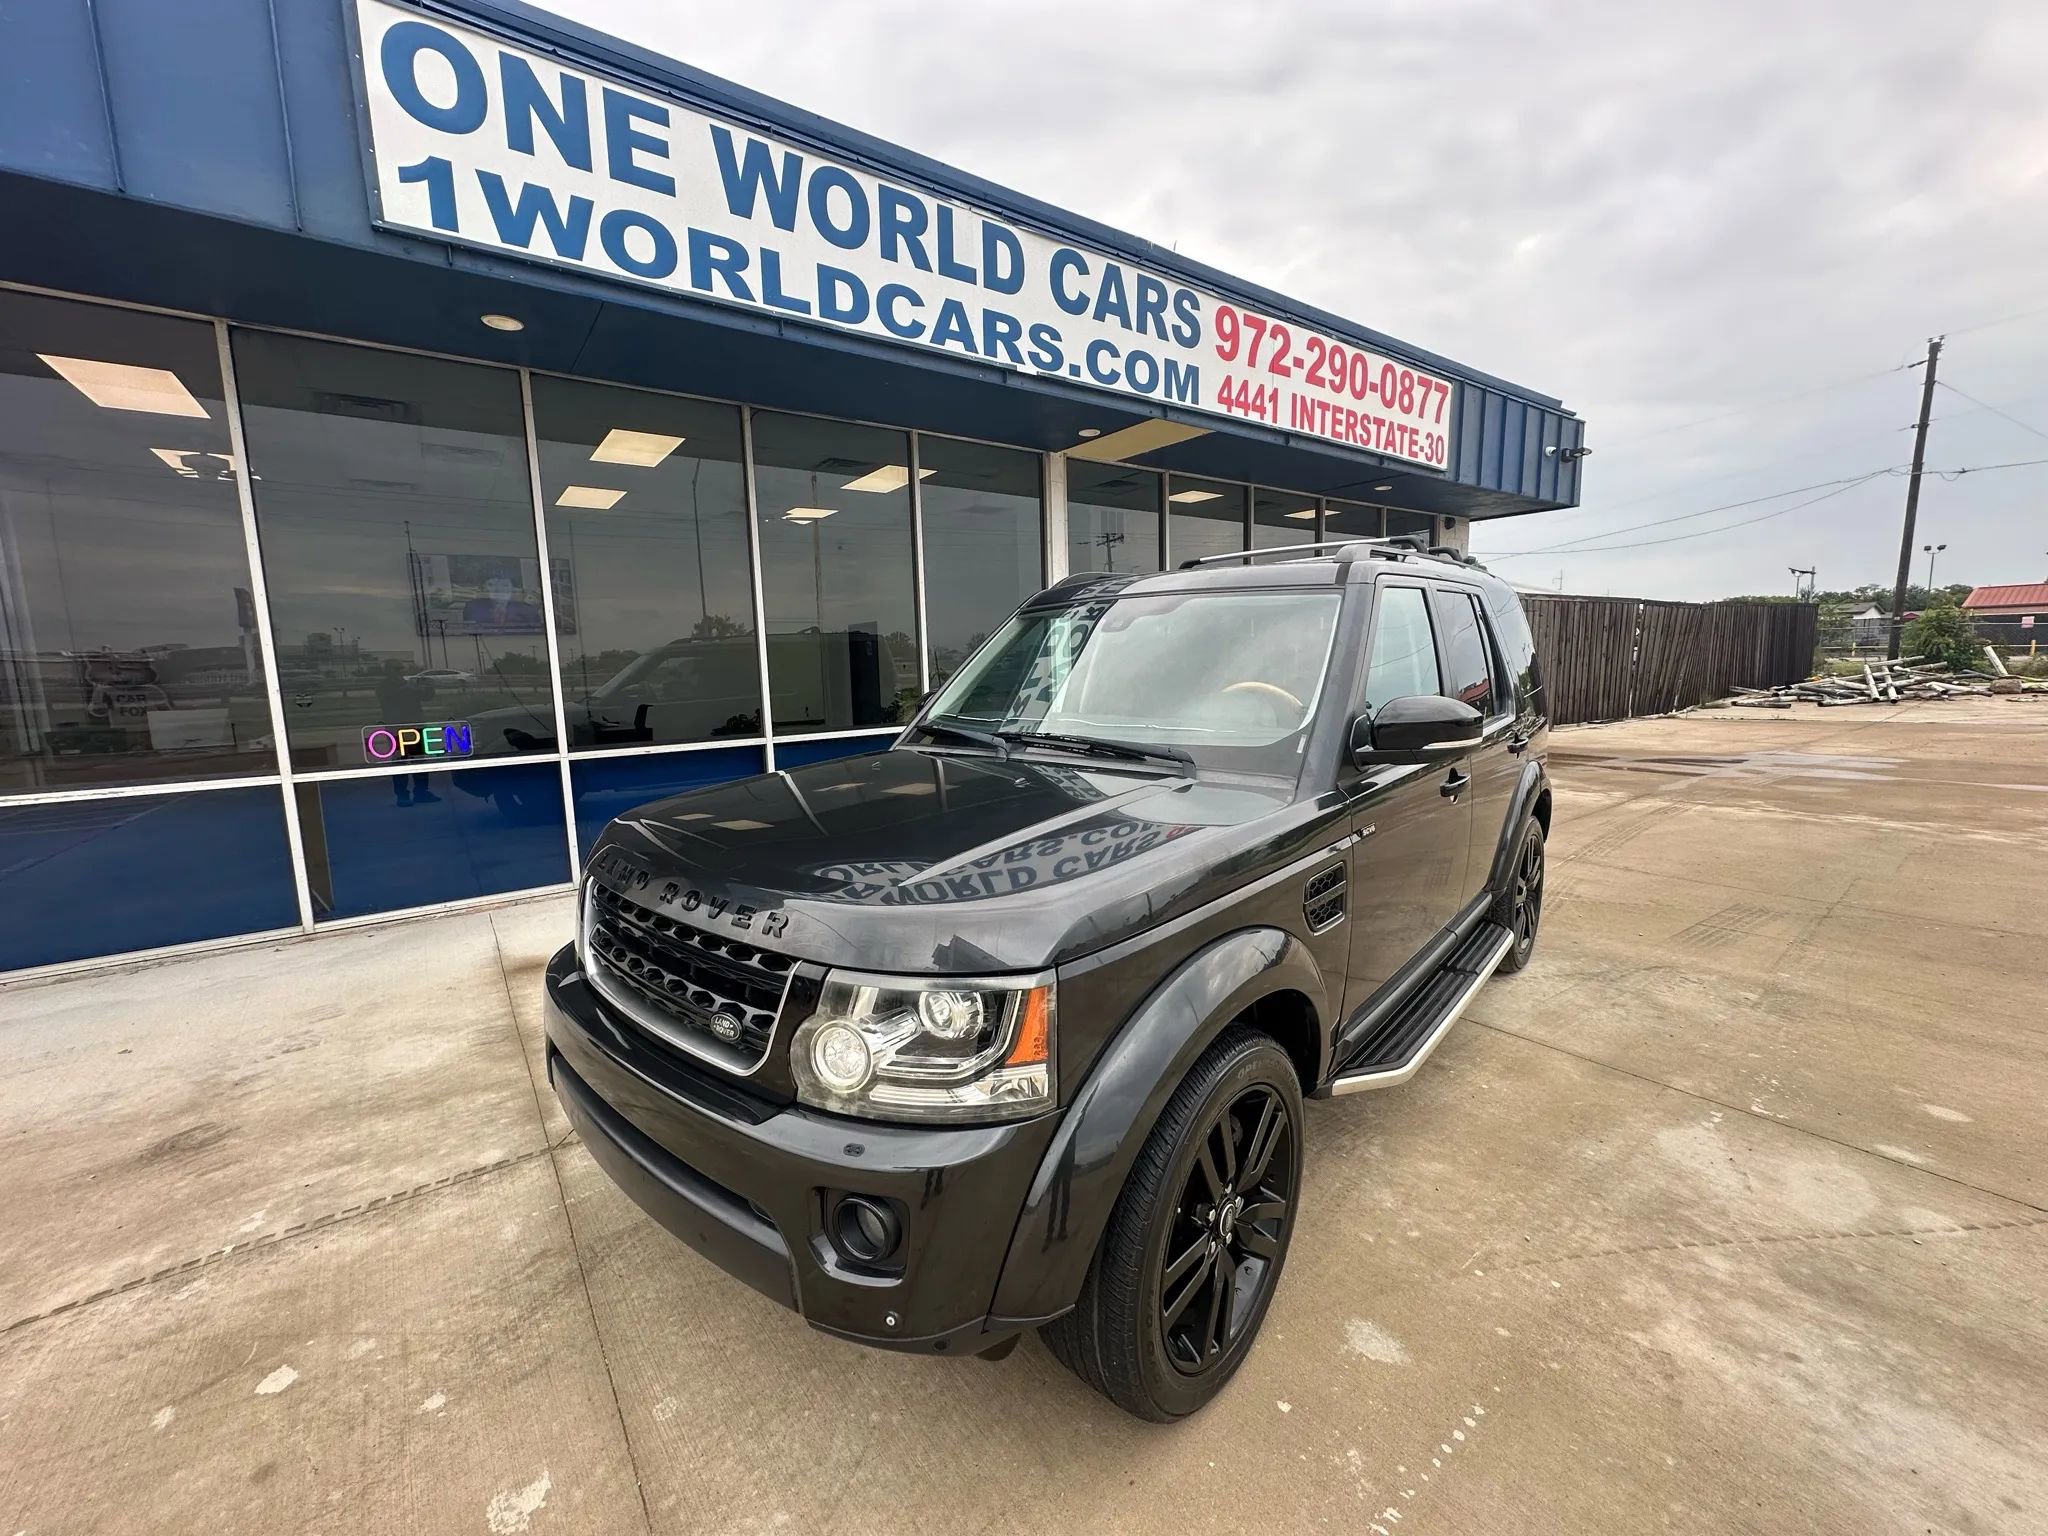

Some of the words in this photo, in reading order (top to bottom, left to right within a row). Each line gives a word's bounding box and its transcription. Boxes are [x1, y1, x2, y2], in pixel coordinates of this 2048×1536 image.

[381, 21, 677, 198] ONE
[710, 125, 1025, 294] WORLD
[1050, 248, 1200, 348] CARS
[398, 156, 1199, 406] 1WORLDCARS.COM
[1215, 305, 1449, 424] 972-290-0877
[1217, 375, 1279, 424] 4441
[1291, 392, 1444, 464] INTERSTATE-30
[367, 725, 472, 758] OPEN
[597, 853, 649, 891] LAND
[659, 881, 789, 938] ROVER
[714, 1016, 731, 1028] LAND
[715, 1025, 735, 1038] ROVER
